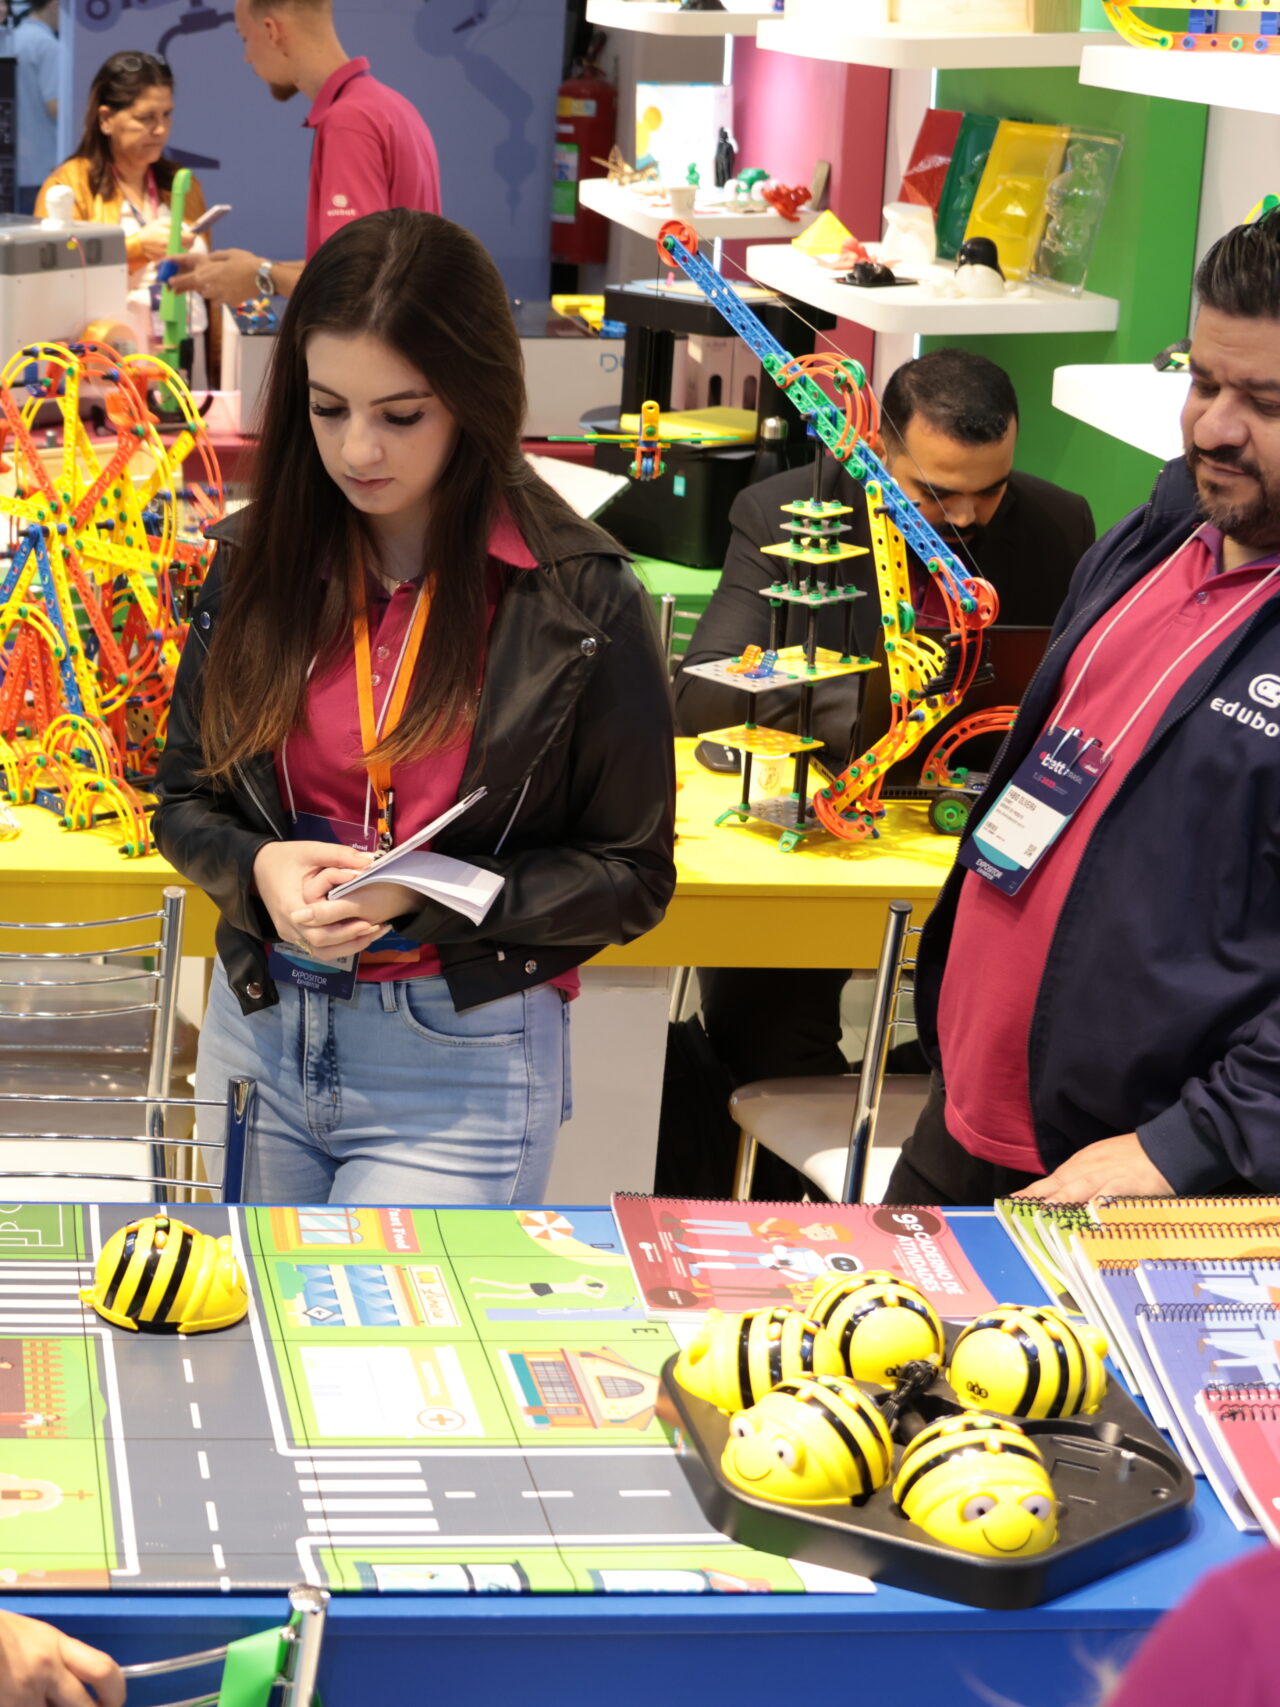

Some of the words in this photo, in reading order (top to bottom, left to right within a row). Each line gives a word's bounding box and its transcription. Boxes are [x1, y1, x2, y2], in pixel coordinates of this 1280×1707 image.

[292, 969, 328, 985] EXPOSITOR
[392, 1228, 411, 1250] Food
[895, 1234, 942, 1292] ATIVIDADES
[914, 1231, 954, 1281] CADERNO
[940, 1281, 965, 1295] DE
